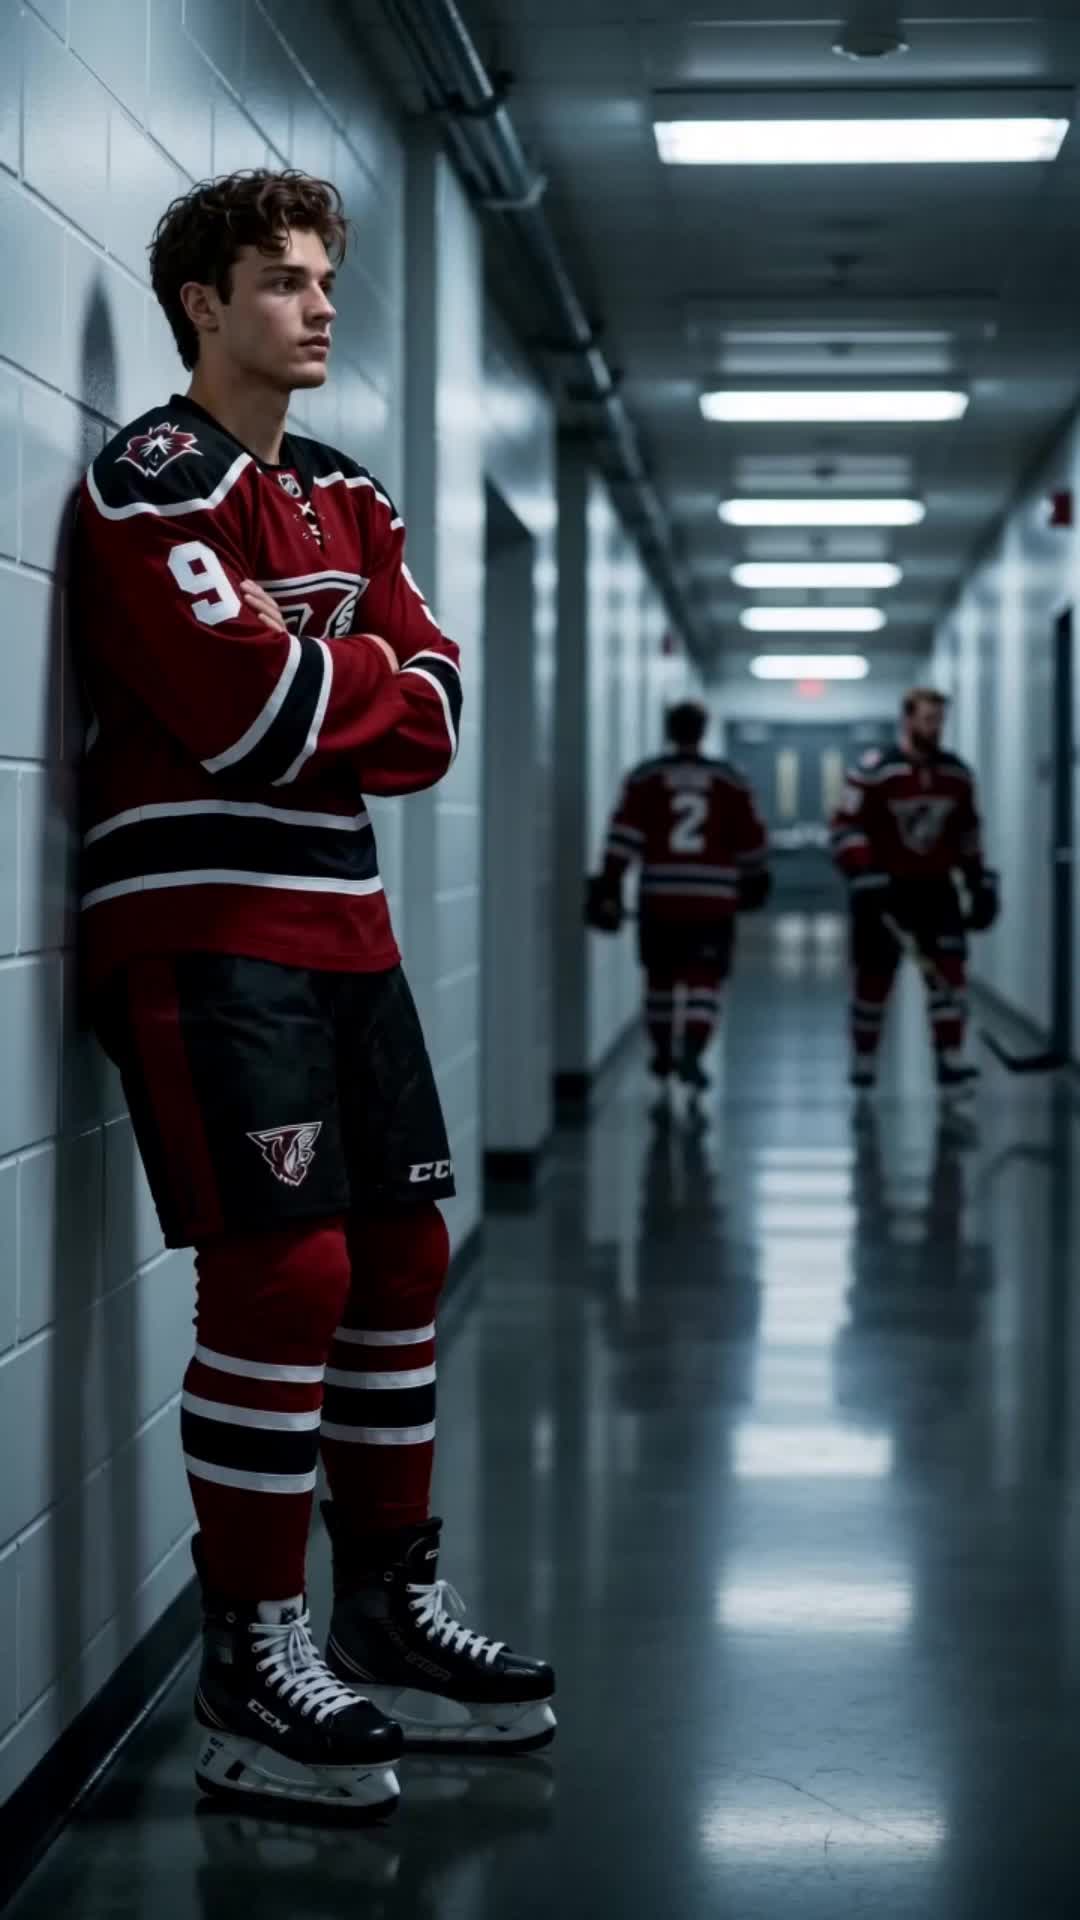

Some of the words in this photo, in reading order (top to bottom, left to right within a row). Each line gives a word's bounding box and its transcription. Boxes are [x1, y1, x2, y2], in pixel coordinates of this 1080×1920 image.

[167, 541, 242, 625] 9
[670, 795, 707, 852] 2
[409, 1160, 454, 1182] CC
[247, 1698, 290, 1734] CCM
